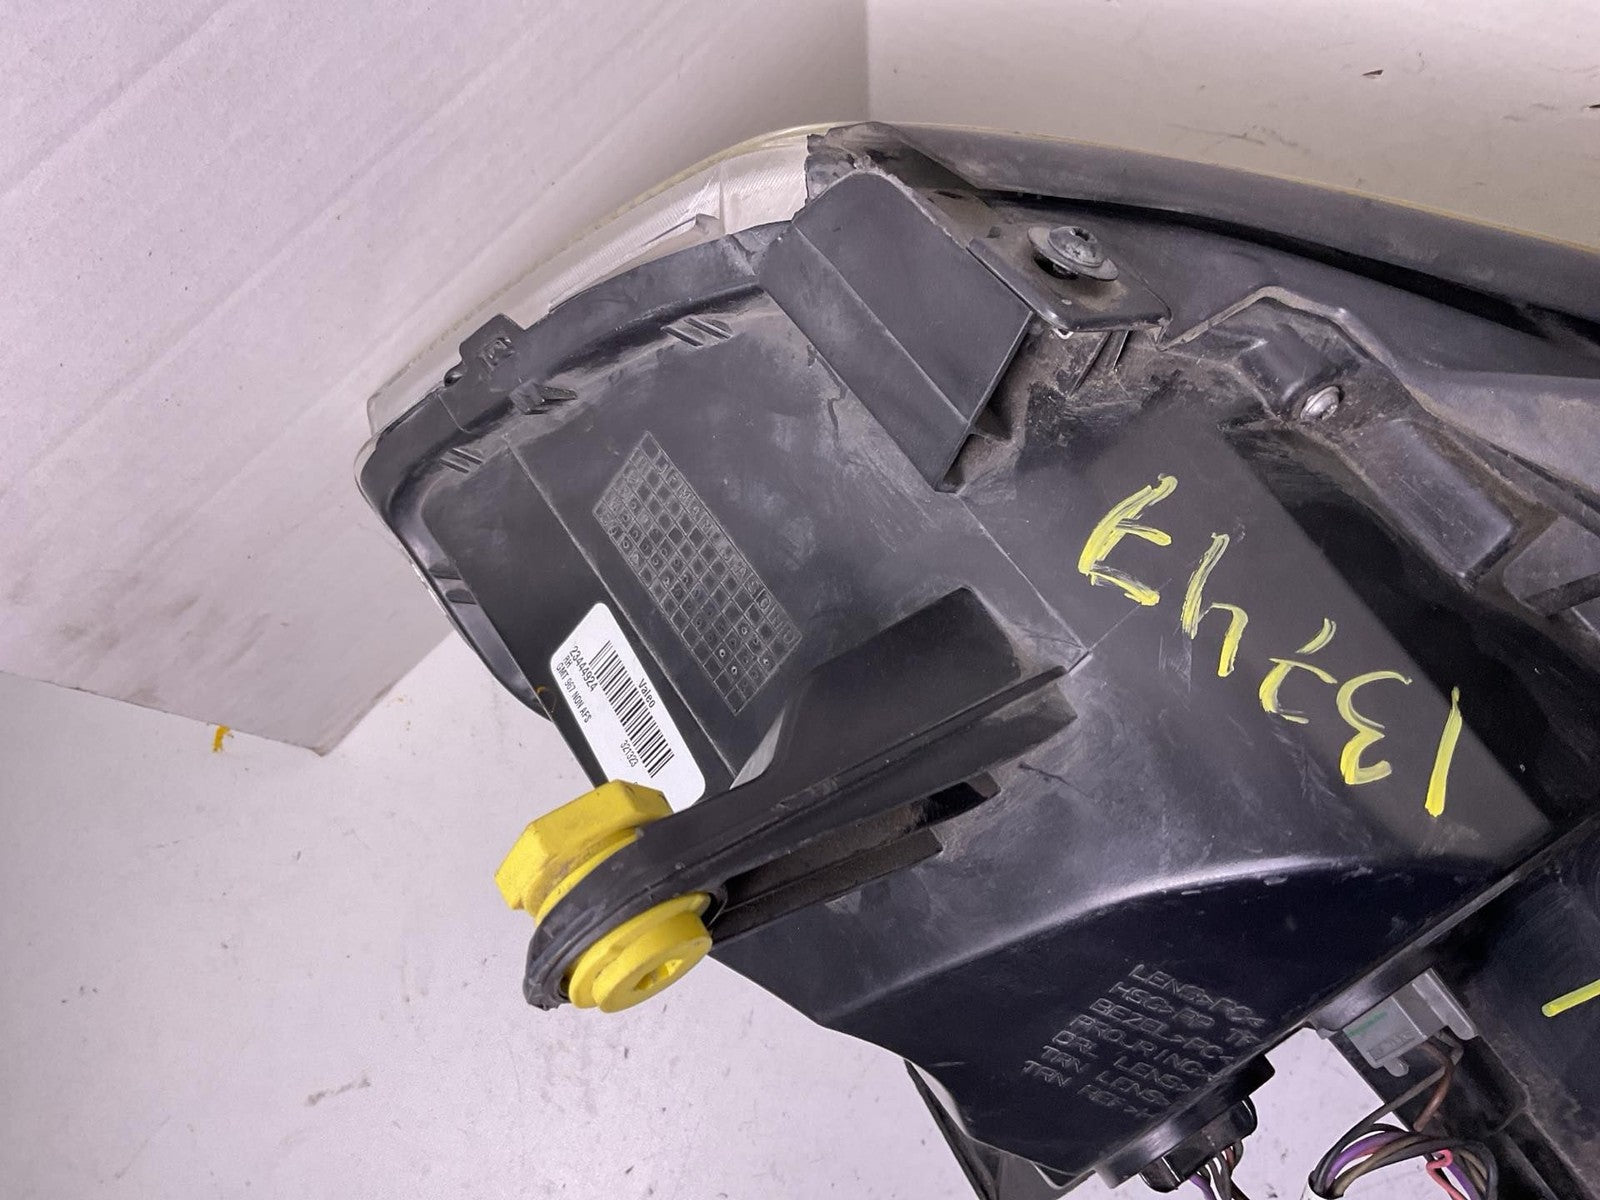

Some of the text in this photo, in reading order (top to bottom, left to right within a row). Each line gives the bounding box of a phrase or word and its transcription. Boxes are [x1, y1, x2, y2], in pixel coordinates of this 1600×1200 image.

[562, 655, 573, 667] RH
[556, 662, 569, 680] GMT
[572, 689, 584, 706] NON
[580, 704, 592, 723] AFS
[569, 645, 639, 767] 23444924 321323
[637, 678, 656, 708] Valeo
